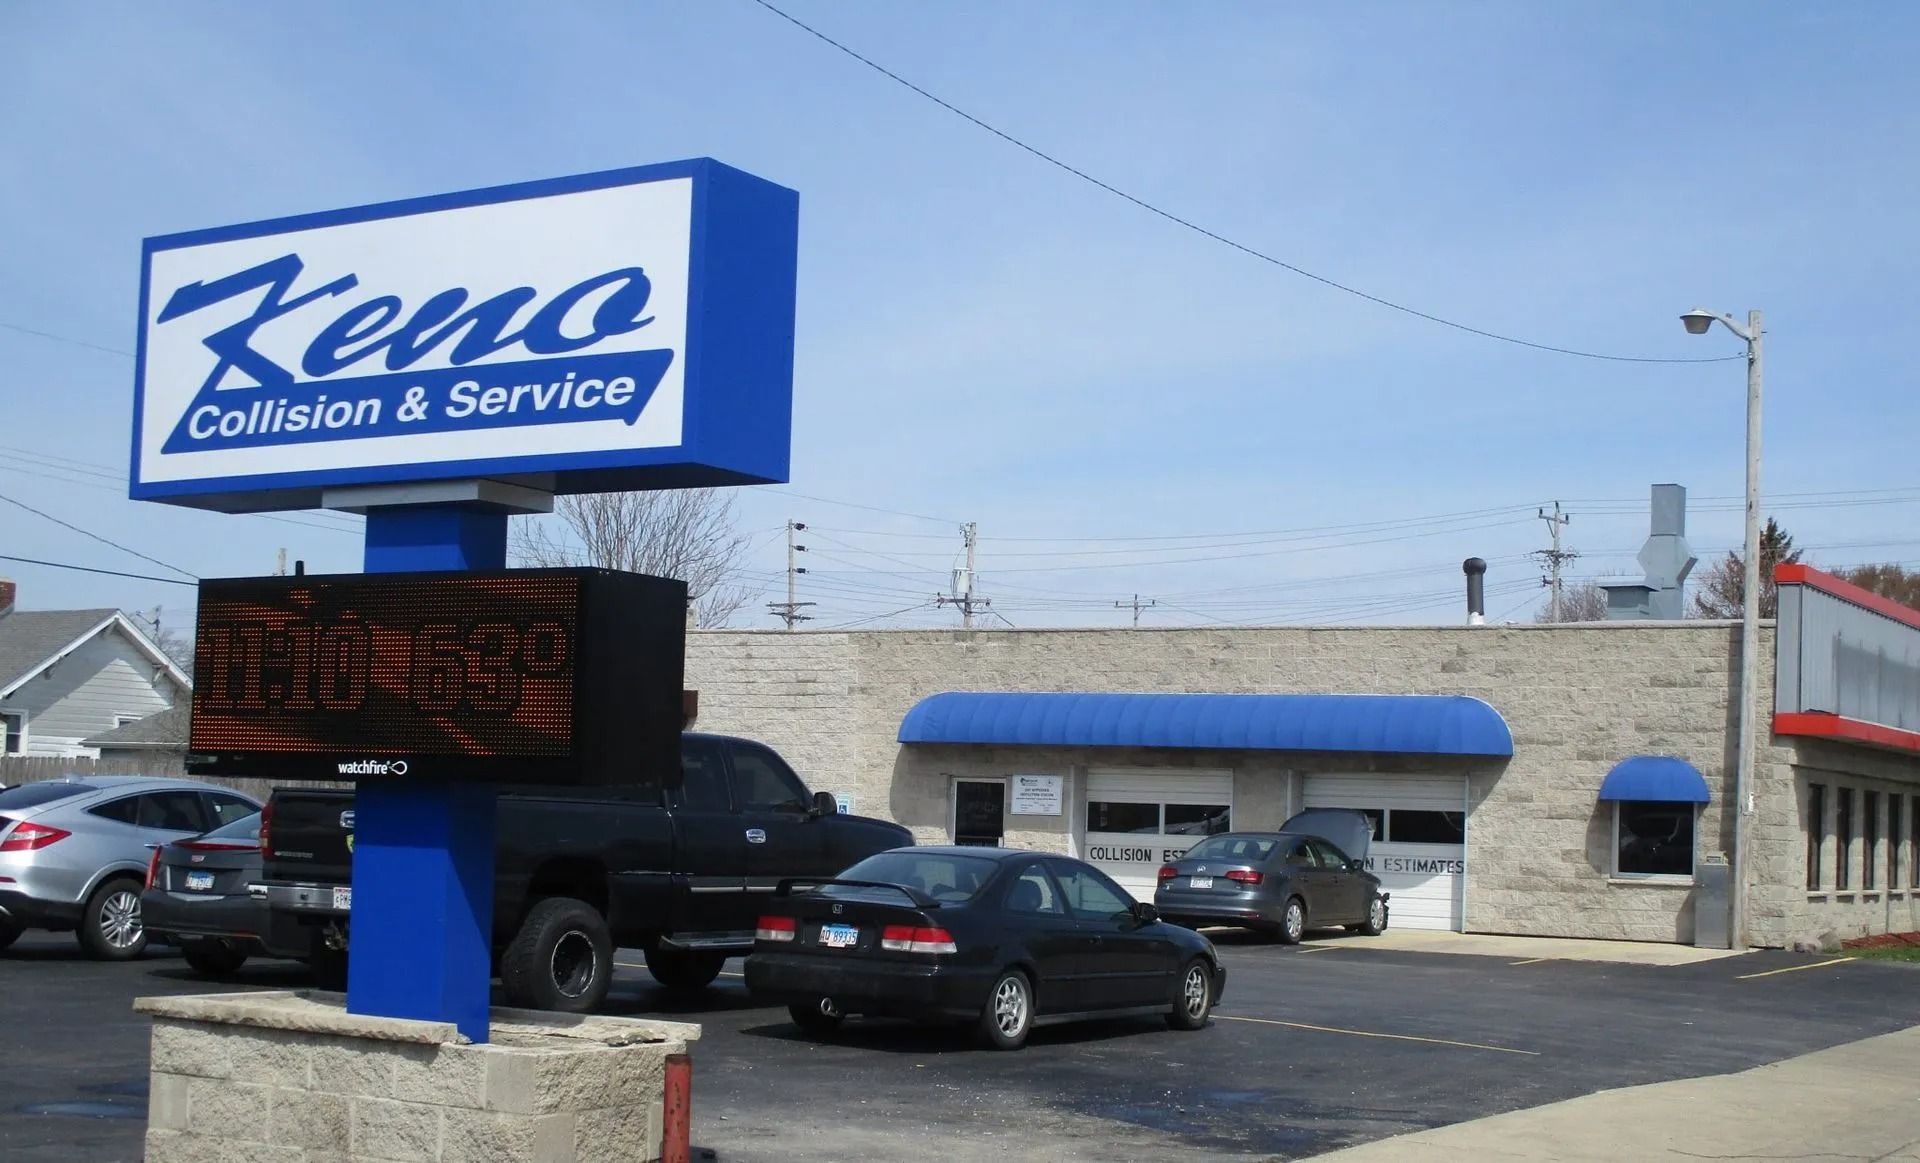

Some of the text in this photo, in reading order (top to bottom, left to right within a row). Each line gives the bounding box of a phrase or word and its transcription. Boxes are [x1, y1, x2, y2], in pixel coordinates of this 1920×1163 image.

[157, 253, 656, 387] Keno
[188, 372, 636, 440] Collision & Service
[1090, 847, 1188, 862] COLLISION EST
[1384, 857, 1464, 874] ESTIMATES
